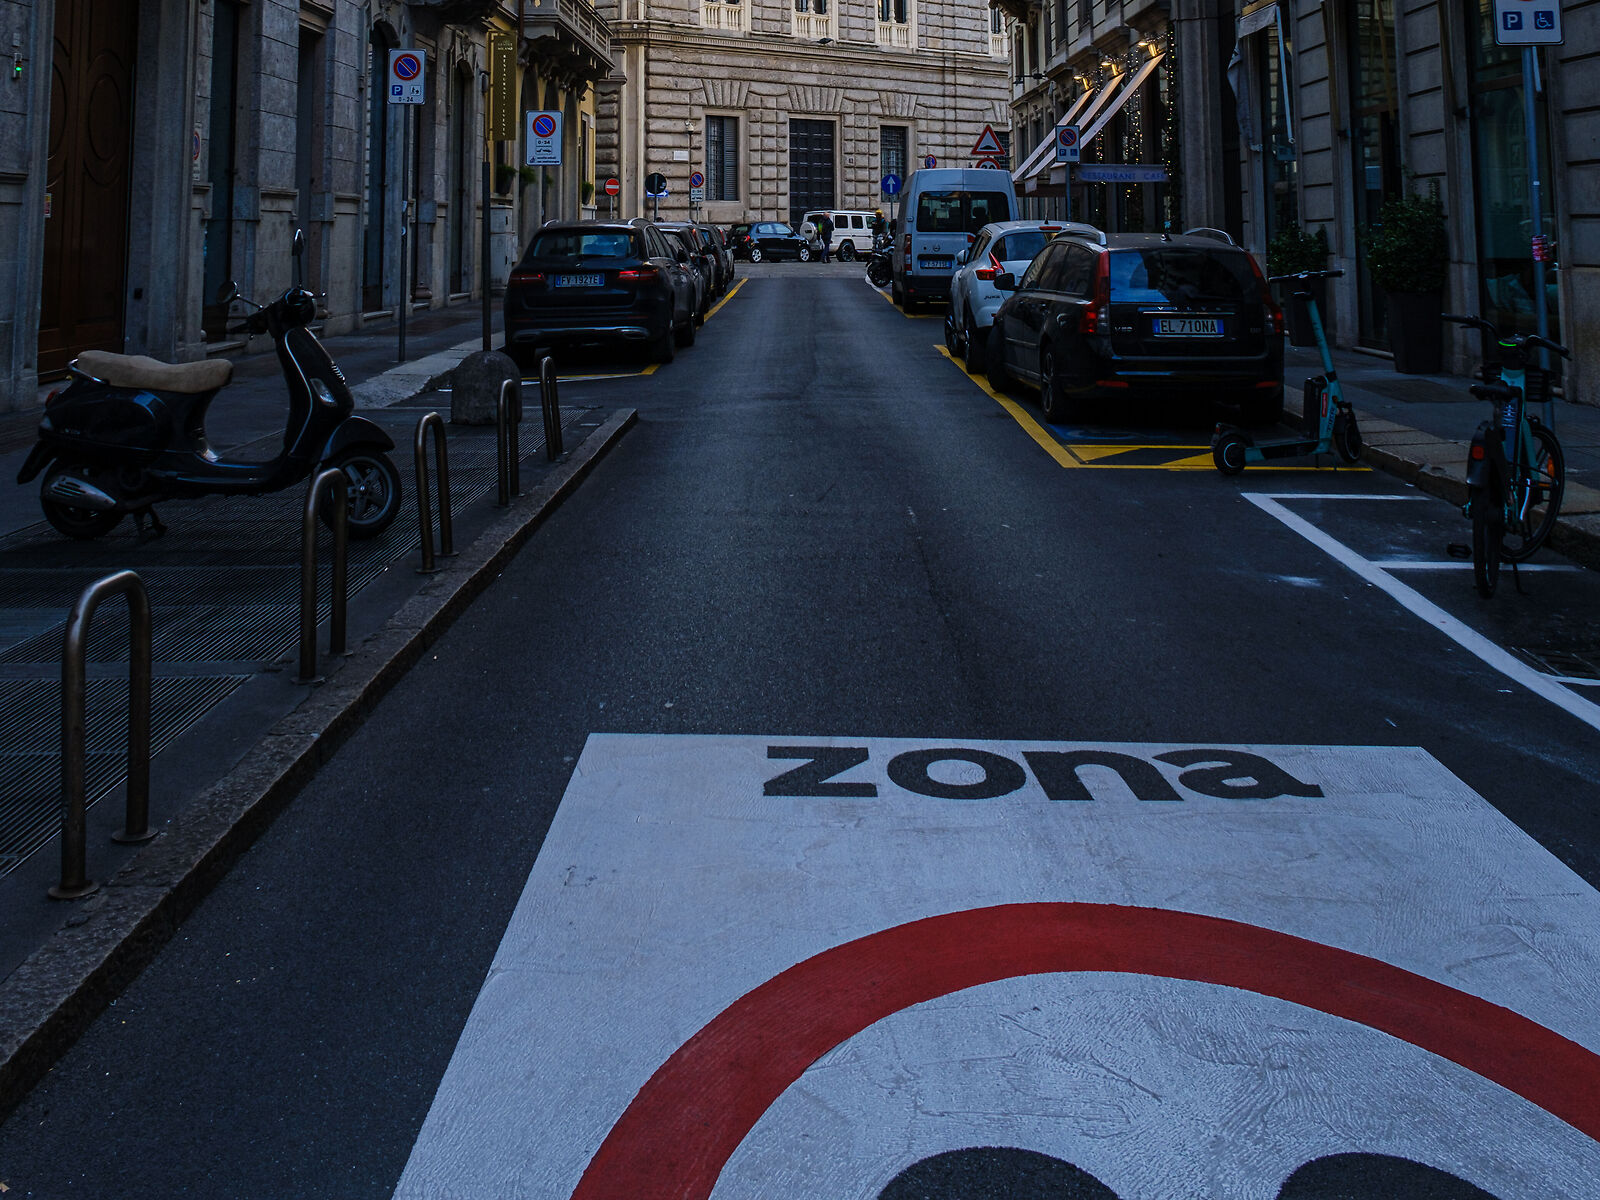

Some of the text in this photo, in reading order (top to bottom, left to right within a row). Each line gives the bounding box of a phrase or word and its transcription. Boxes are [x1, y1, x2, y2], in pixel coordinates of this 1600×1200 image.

[1507, 14, 1518, 29] P
[1160, 320, 1217, 333] EL 710NA
[763, 745, 1325, 801] zona
